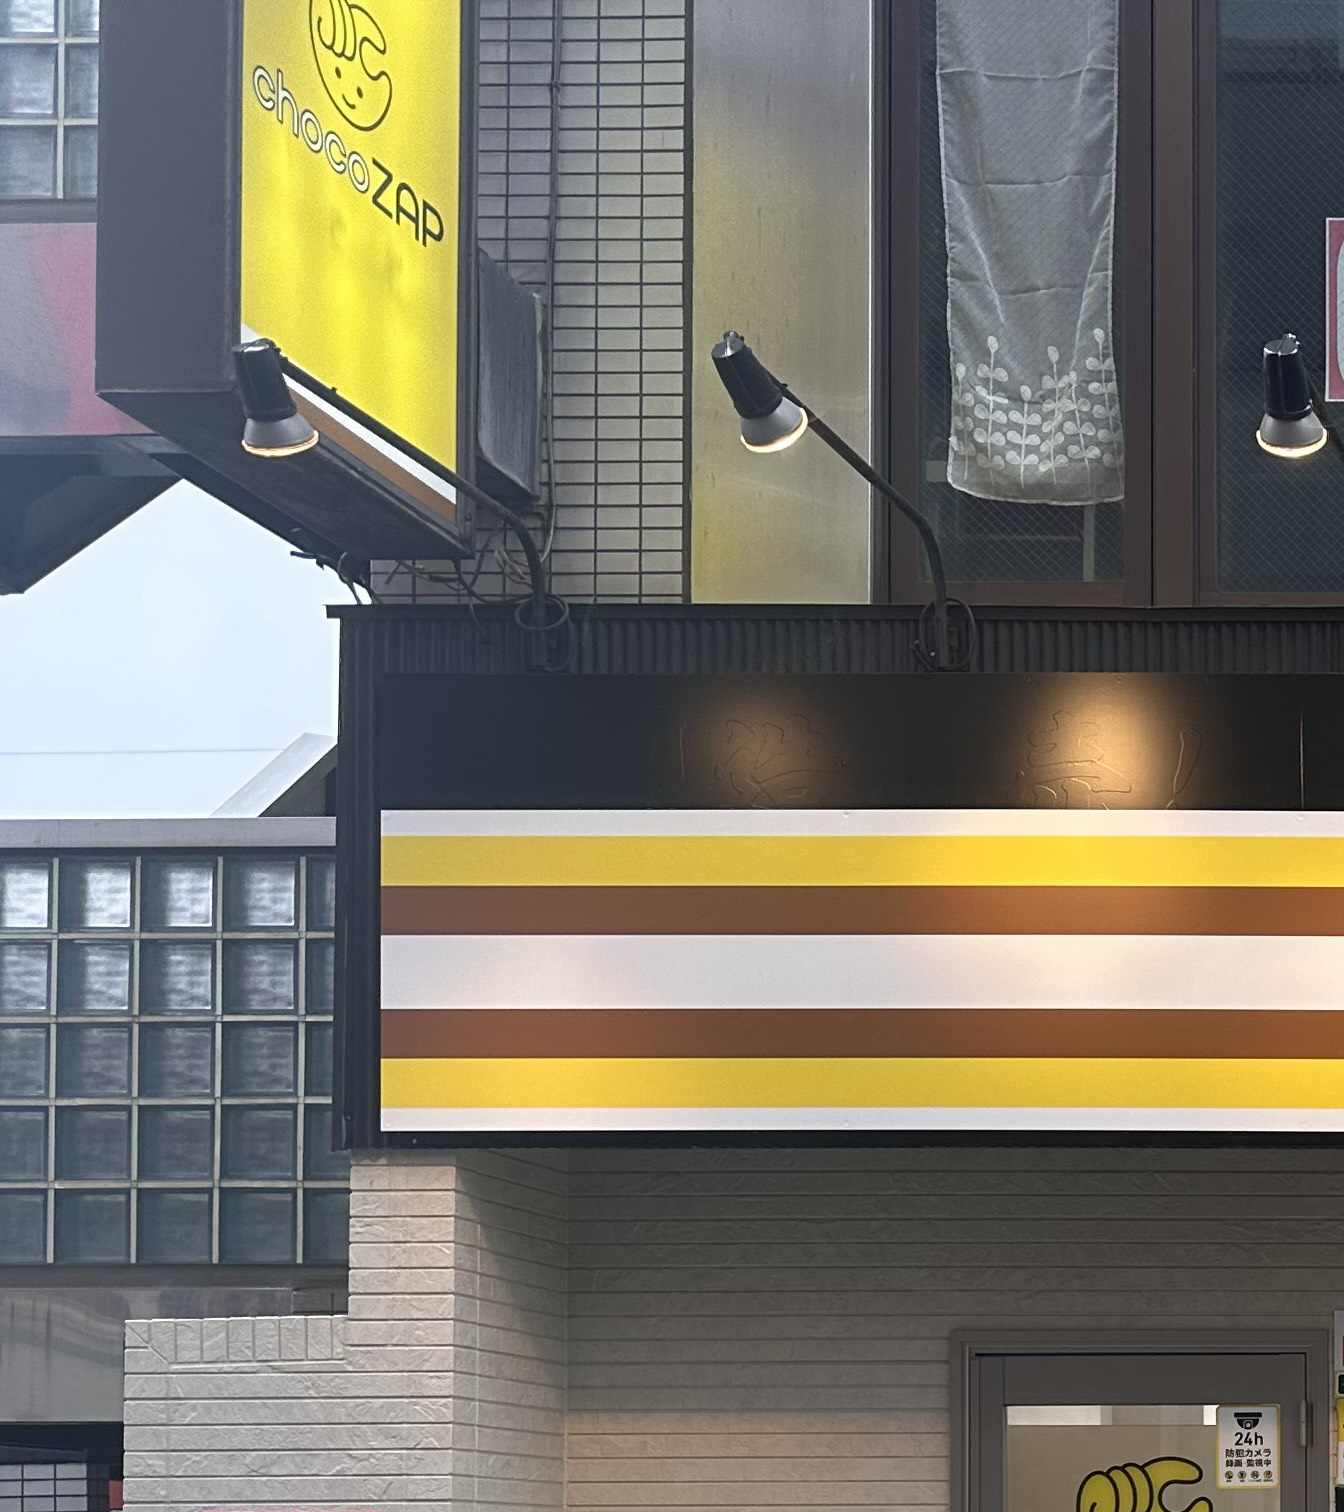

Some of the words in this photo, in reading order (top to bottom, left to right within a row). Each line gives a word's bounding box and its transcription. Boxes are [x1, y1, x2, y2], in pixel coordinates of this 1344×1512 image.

[252, 65, 444, 248] chocoZAP
[1234, 1431, 1264, 1446] 24h
[1225, 1448, 1272, 1459] 防犯カメラ
